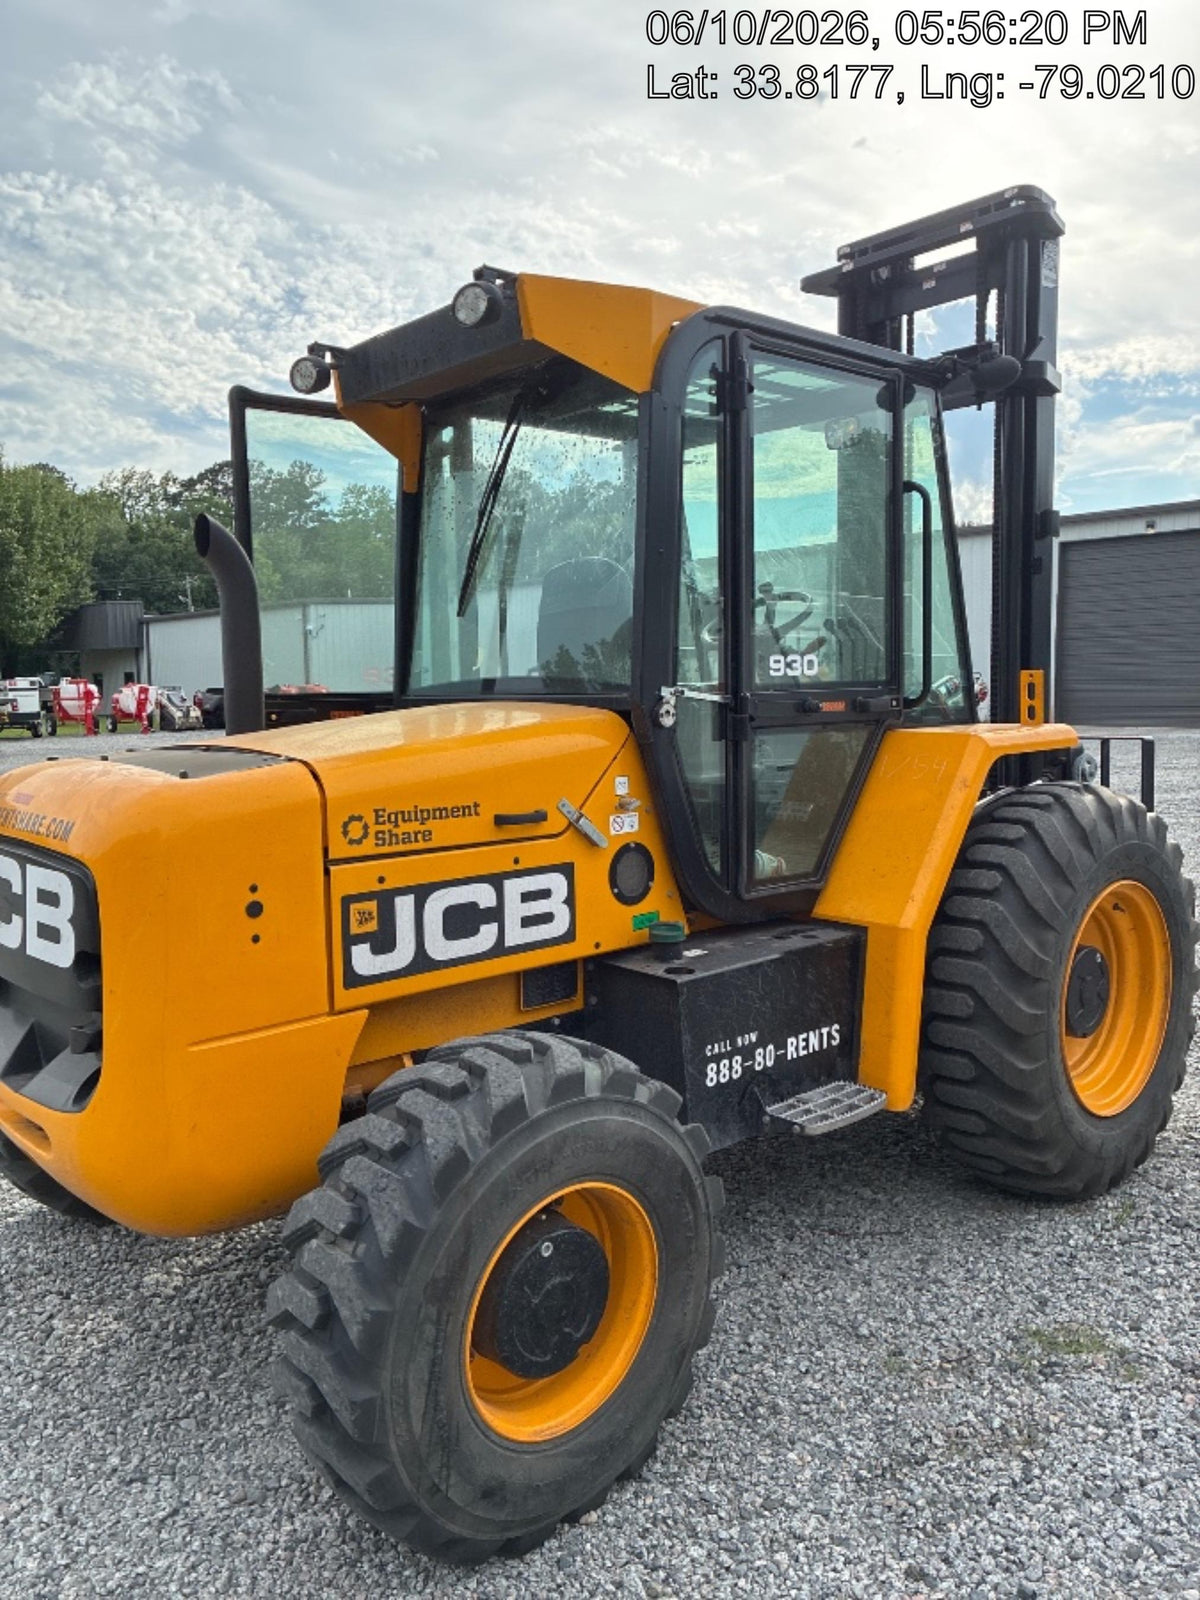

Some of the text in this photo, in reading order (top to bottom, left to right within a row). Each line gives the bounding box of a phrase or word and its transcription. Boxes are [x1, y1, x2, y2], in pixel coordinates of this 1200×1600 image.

[769, 653, 818, 676] 930
[373, 801, 480, 828] Equipment
[374, 828, 433, 847] Share
[351, 872, 571, 977] JCB
[705, 1031, 759, 1057] CALL NOW
[705, 1023, 841, 1088] 888-80-RENTS
